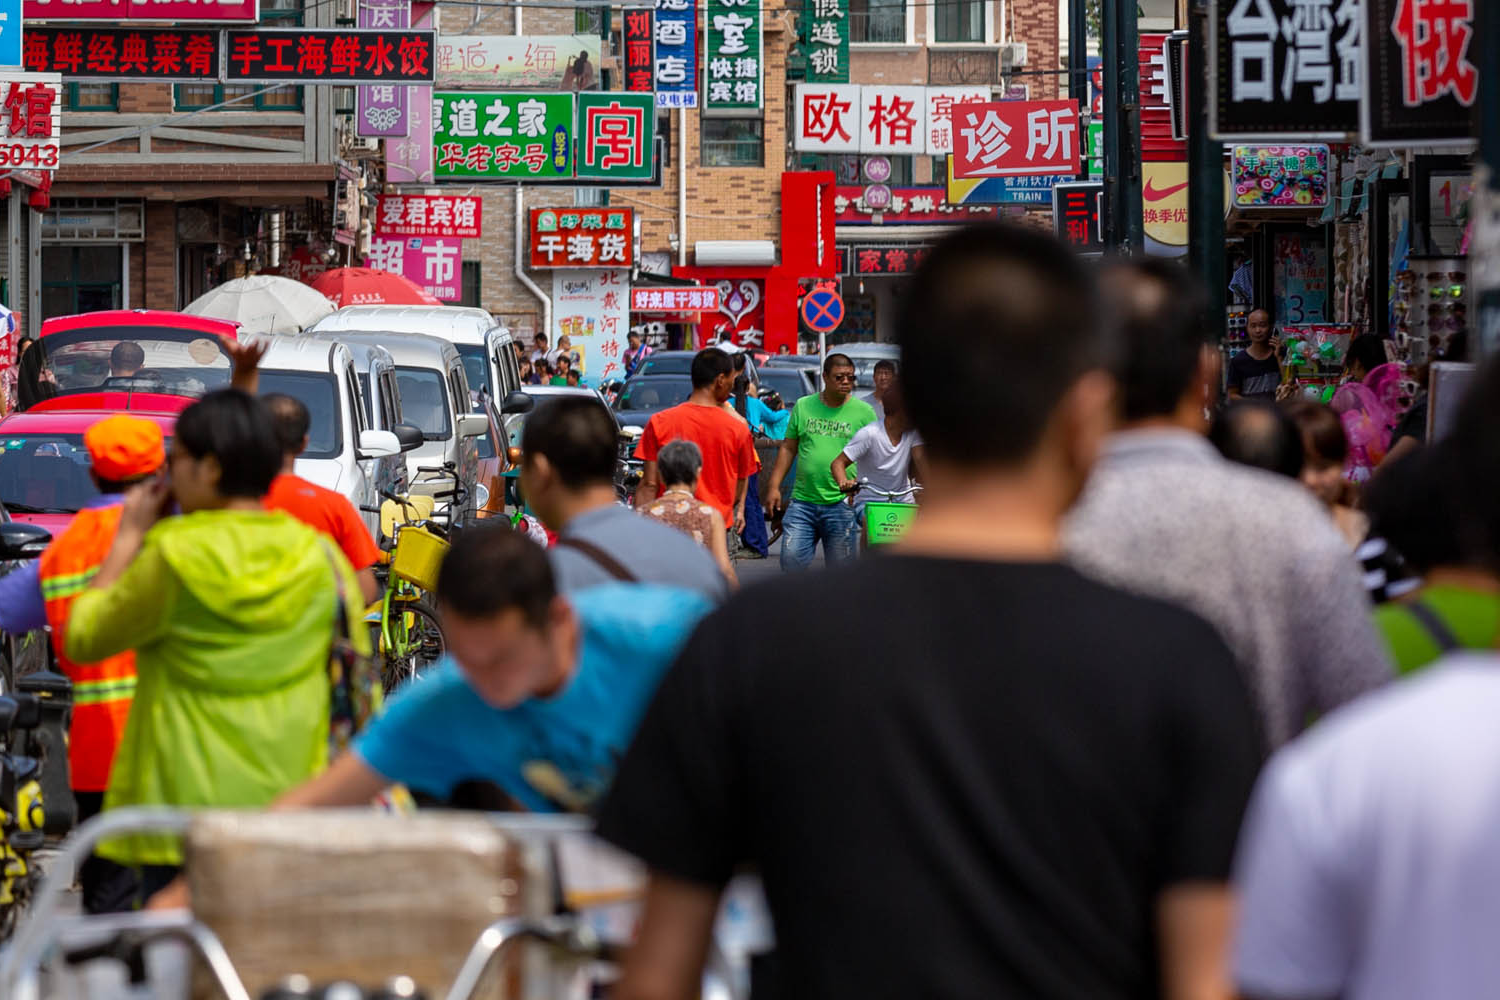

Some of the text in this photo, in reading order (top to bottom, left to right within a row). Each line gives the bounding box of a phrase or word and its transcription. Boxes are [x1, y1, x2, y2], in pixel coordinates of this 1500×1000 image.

[23, 32, 215, 76] 海鲜经典菜肴
[231, 35, 429, 77] 手工海鲜水饺
[709, 57, 758, 79] 快捷
[709, 81, 758, 103] 宾馆
[802, 92, 917, 146] 欧格
[961, 107, 1076, 165] 诊所
[433, 143, 548, 173] 华老字号
[1244, 155, 1320, 172] 手工糖果
[1012, 191, 1042, 201] TRAIN
[382, 197, 477, 227] 爱君宾馆
[368, 238, 459, 285] 超市
[536, 232, 627, 263] 干海货
[600, 270, 621, 380] 北戴河特产
